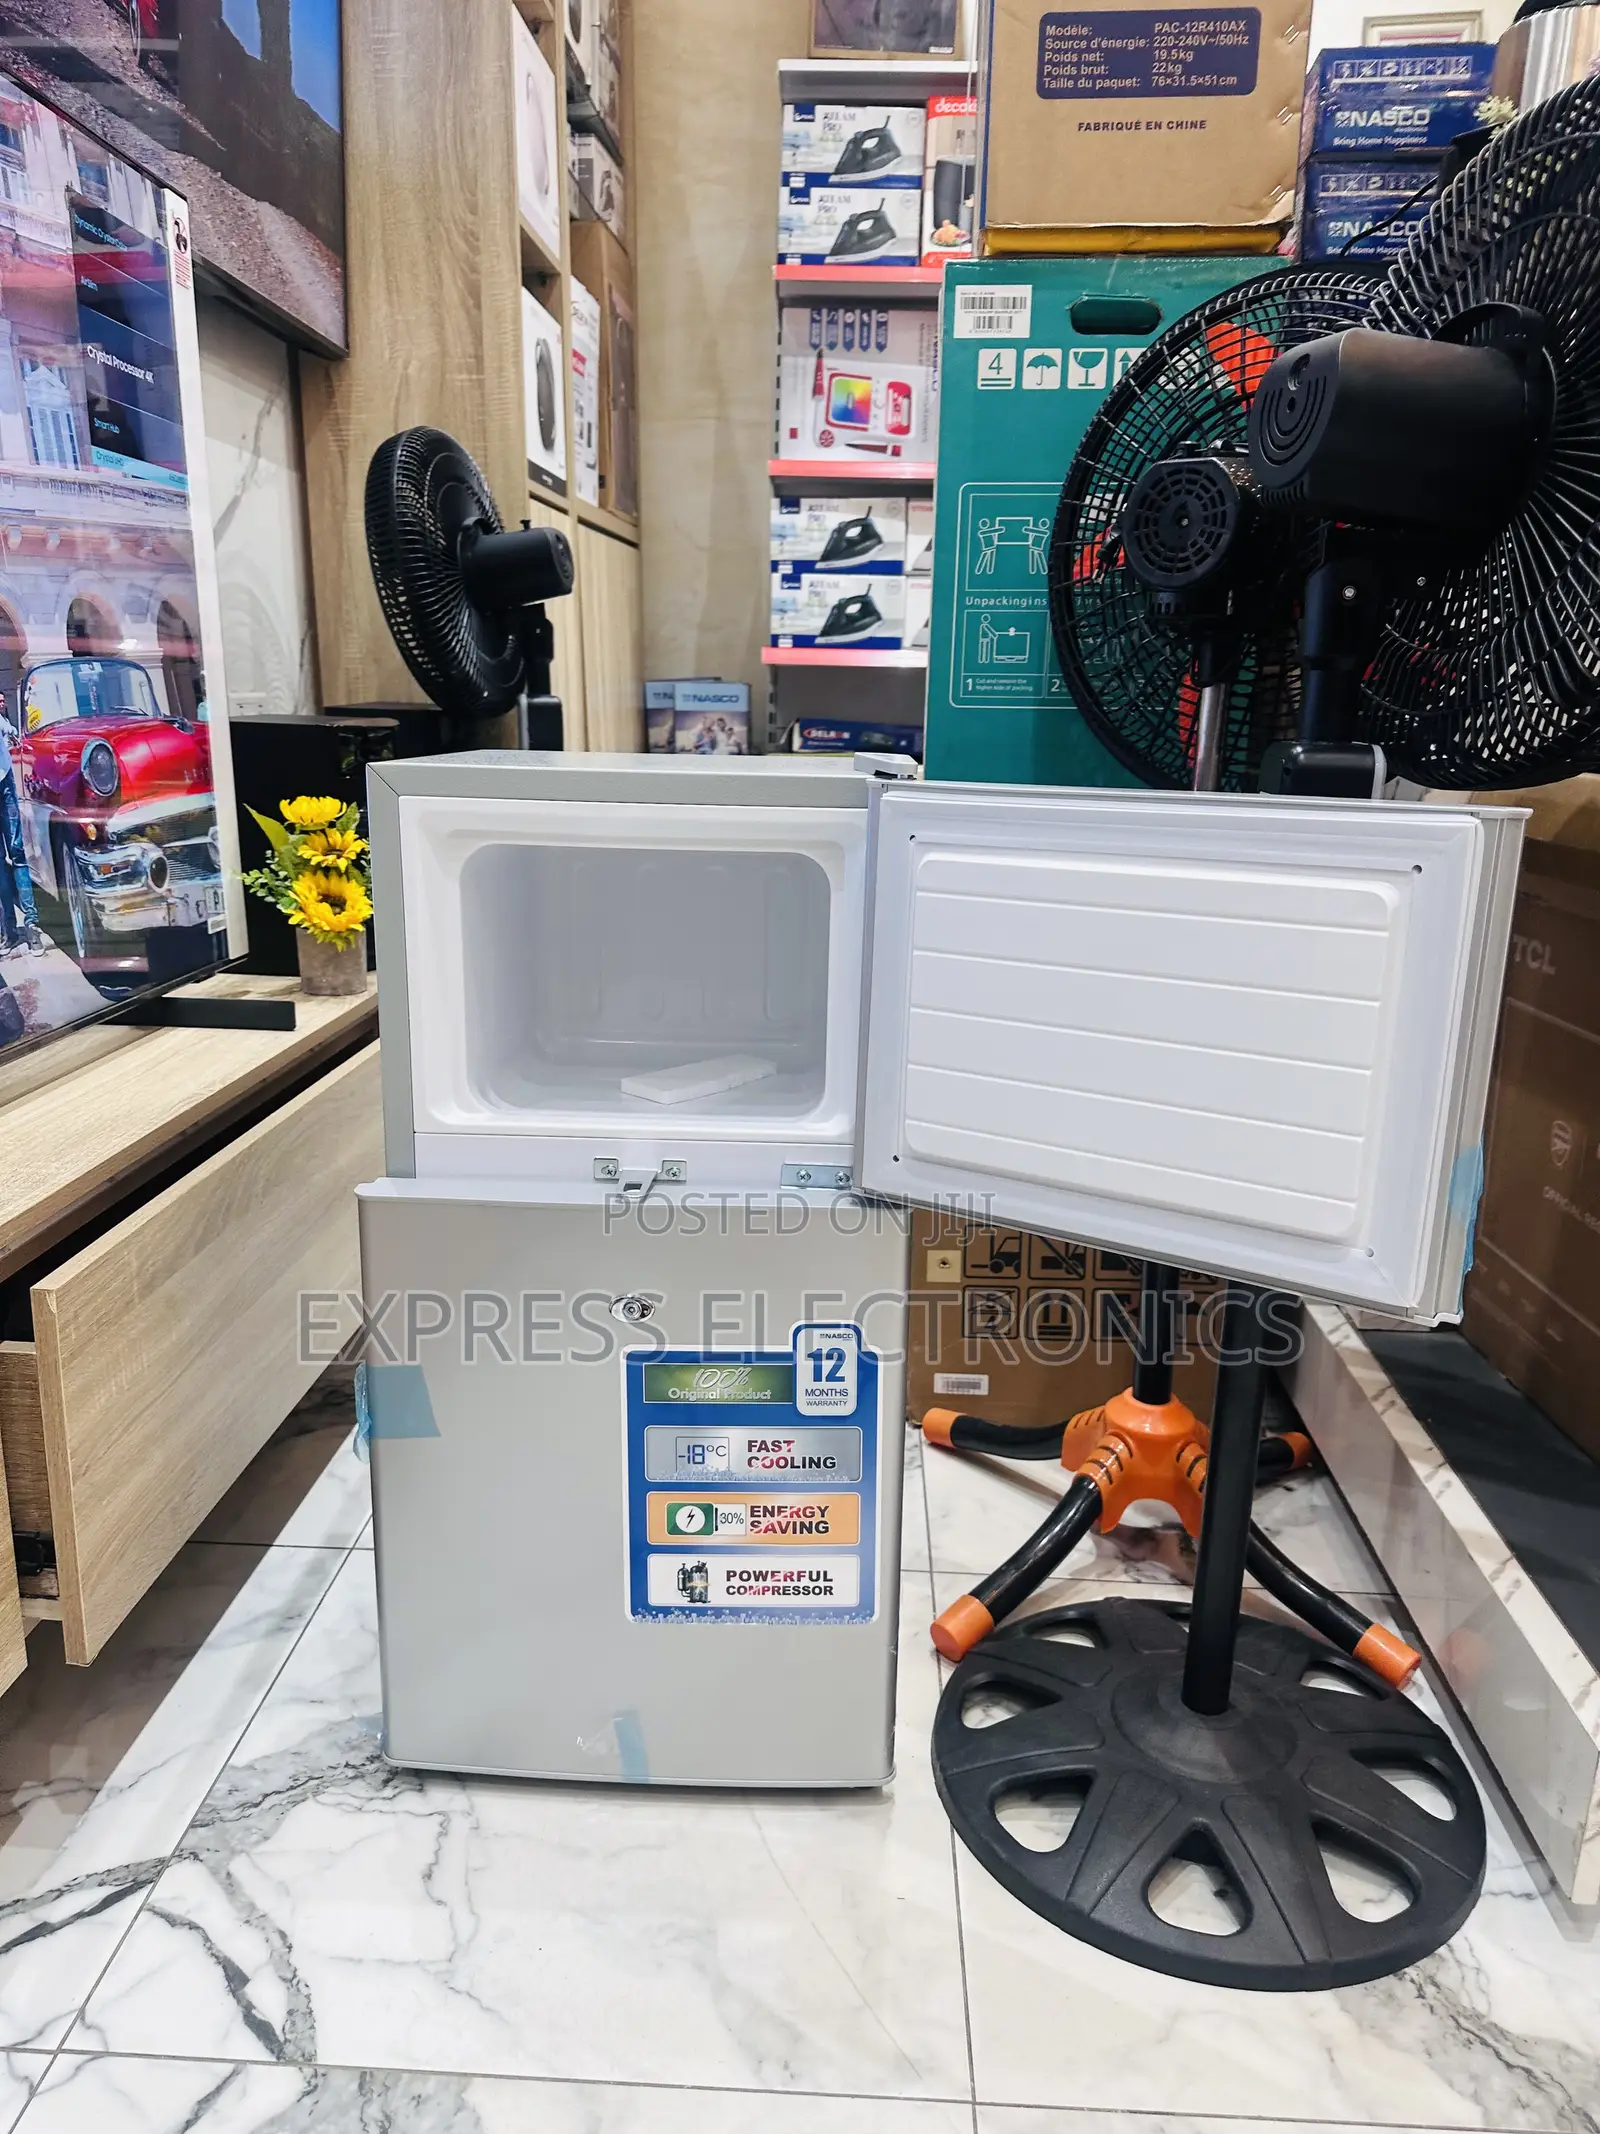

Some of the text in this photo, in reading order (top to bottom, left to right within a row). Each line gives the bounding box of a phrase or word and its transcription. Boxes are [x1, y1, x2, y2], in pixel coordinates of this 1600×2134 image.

[1046, 20, 1247, 36] Modèle: PAC-12R410AX
[1045, 38, 1087, 49] Source
[1090, 37, 1150, 50] d'énergie:
[1044, 51, 1078, 62] Poids
[1081, 52, 1104, 61] net:
[1044, 65, 1078, 76] Poids
[1080, 64, 1109, 75] brut:
[1044, 77, 1075, 89] Taille
[1077, 77, 1093, 88] du
[1096, 77, 1141, 91] paquet:
[1349, 109, 1430, 127] NASCO
[1077, 119, 1207, 132] FABRIQUÉ EN CHINE
[1358, 137, 1383, 146] Home
[1384, 136, 1428, 147] Happiness
[87, 345, 154, 384] Crystal Processor 4K
[966, 678, 974, 691] 1
[1051, 679, 1060, 692] 2
[692, 694, 739, 703] NASCO
[1513, 934, 1557, 976] TCL
[807, 1347, 846, 1383] 12
[692, 1367, 752, 1389] 100%
[668, 1388, 772, 1402] Original Product
[805, 1388, 848, 1397] MONTHS
[747, 1440, 796, 1453] FAST
[747, 1456, 837, 1470] COOLING
[719, 1512, 744, 1525] 30%
[750, 1505, 830, 1519] ENERGY
[749, 1520, 830, 1535] SAVING
[726, 1570, 834, 1582] POWERFUL
[725, 1585, 834, 1596] COMPRESSOR
